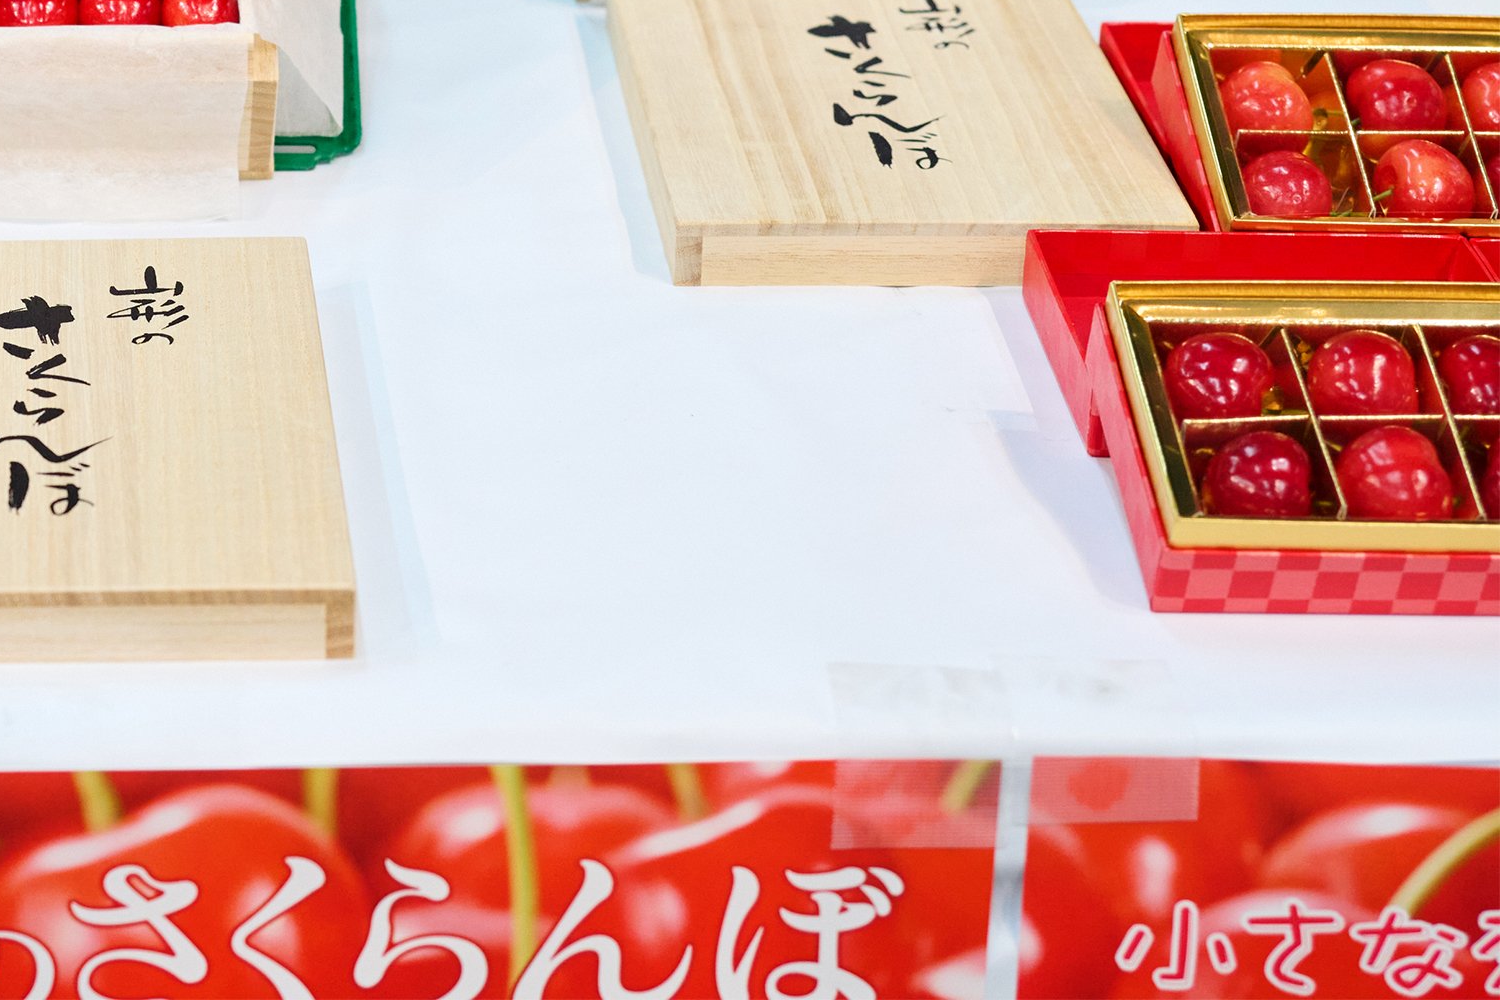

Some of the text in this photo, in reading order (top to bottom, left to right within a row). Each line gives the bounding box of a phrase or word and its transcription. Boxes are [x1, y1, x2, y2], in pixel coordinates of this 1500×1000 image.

[807, 14, 953, 170] さくらんぼ
[1115, 898, 1500, 999] 小さな
